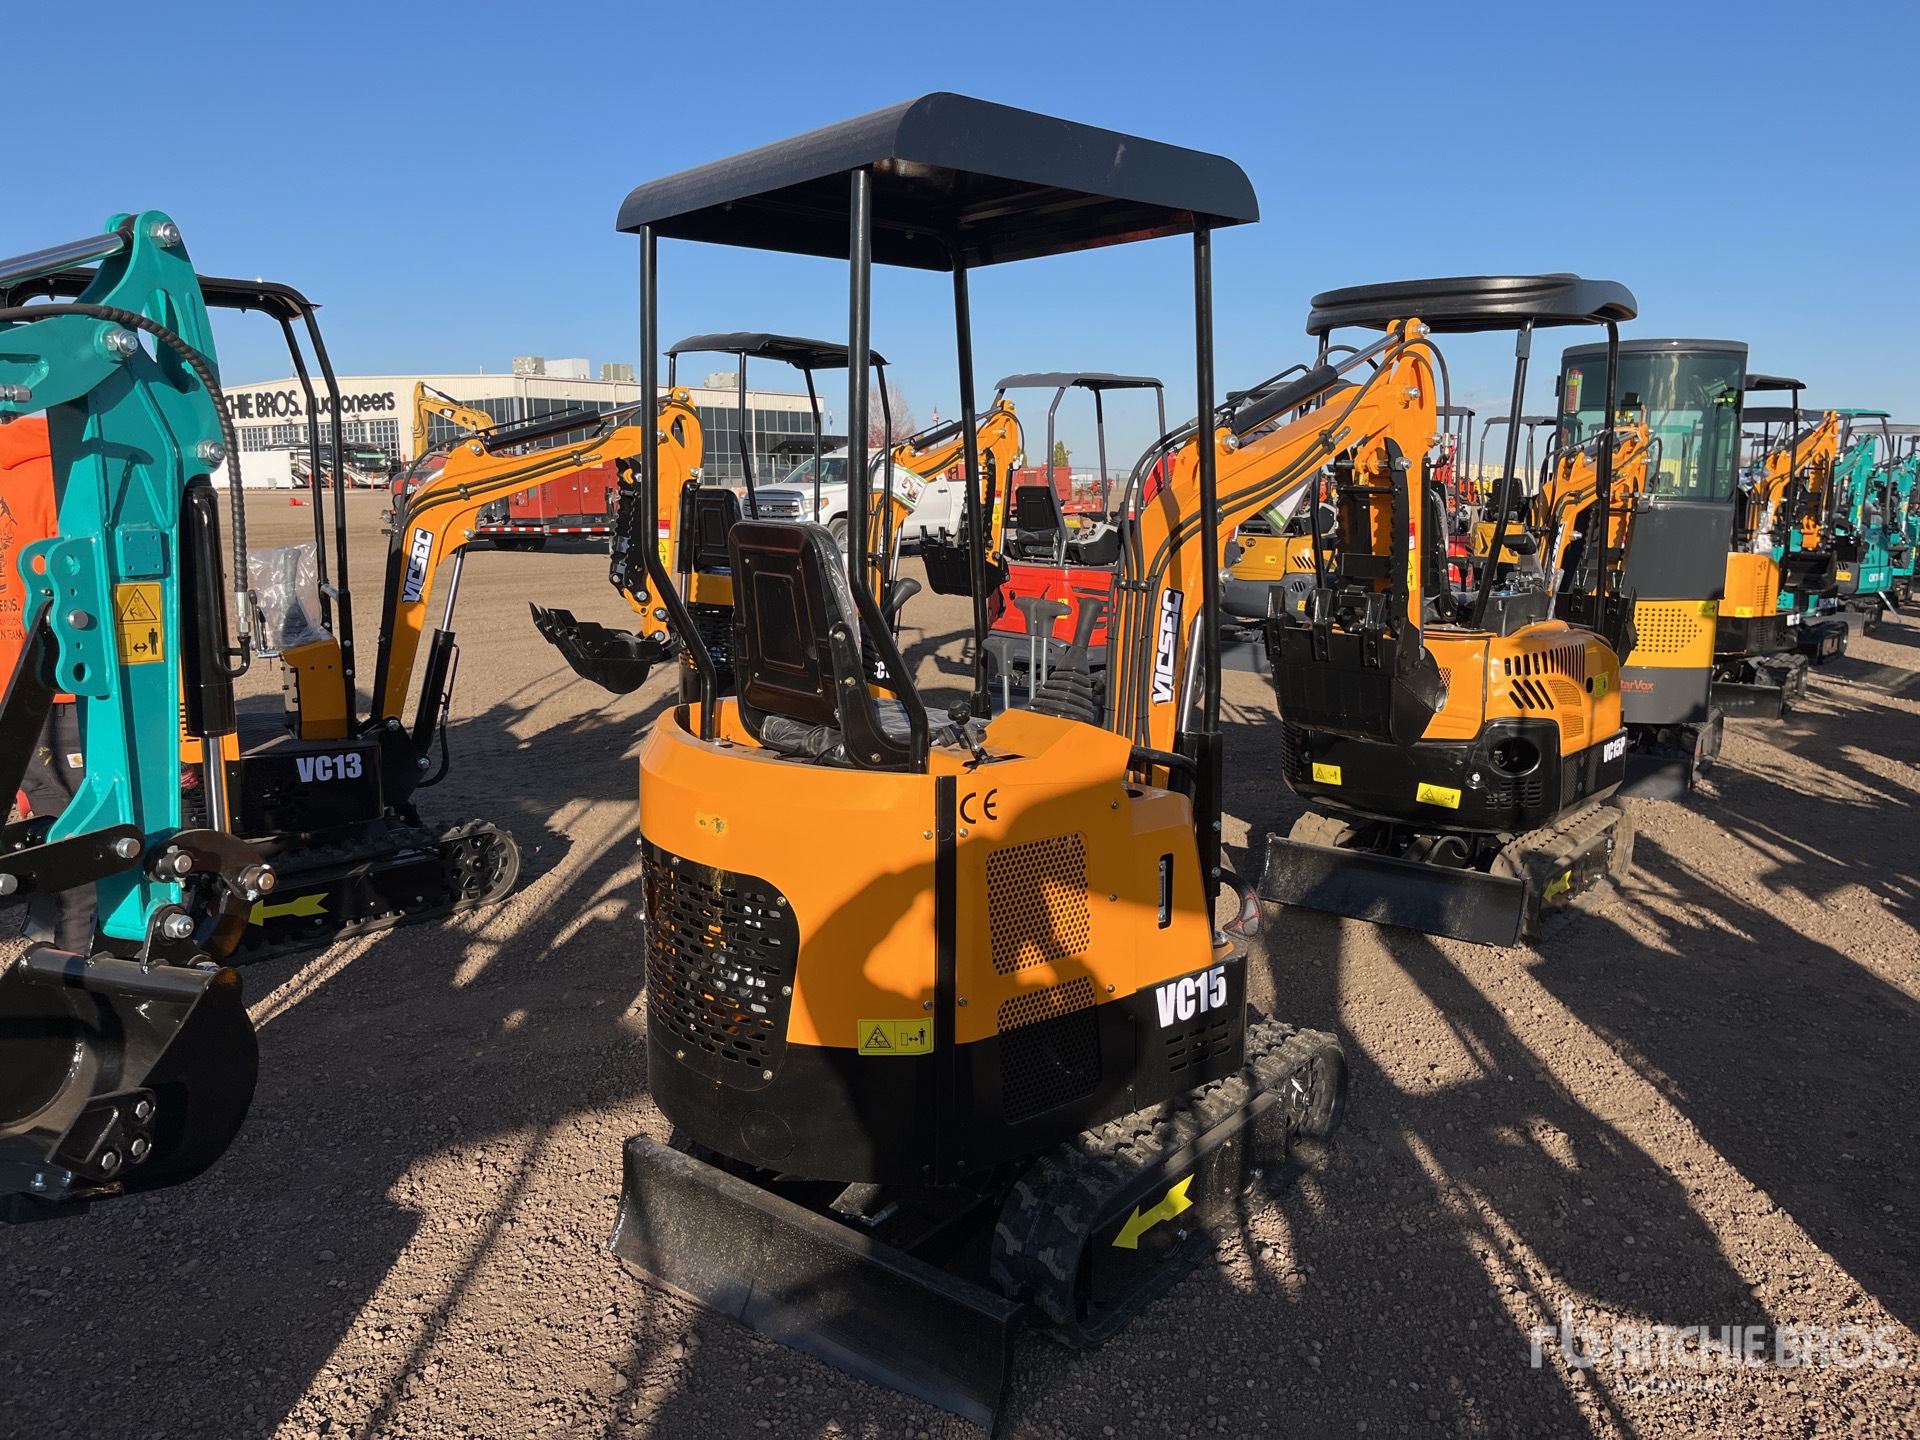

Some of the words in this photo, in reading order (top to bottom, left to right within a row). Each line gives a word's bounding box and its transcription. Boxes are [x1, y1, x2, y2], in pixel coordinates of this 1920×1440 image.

[225, 393, 254, 419] CHIE
[255, 390, 303, 418] BROS.
[305, 391, 395, 416] uconeers
[402, 528, 434, 603] VICSEC
[1151, 587, 1184, 706] VICSEC
[1620, 679, 1654, 690] tarVox
[1603, 736, 1626, 763] VC15P
[296, 753, 362, 783] VC13
[959, 788, 998, 824] CE
[1156, 966, 1228, 1028] VC15
